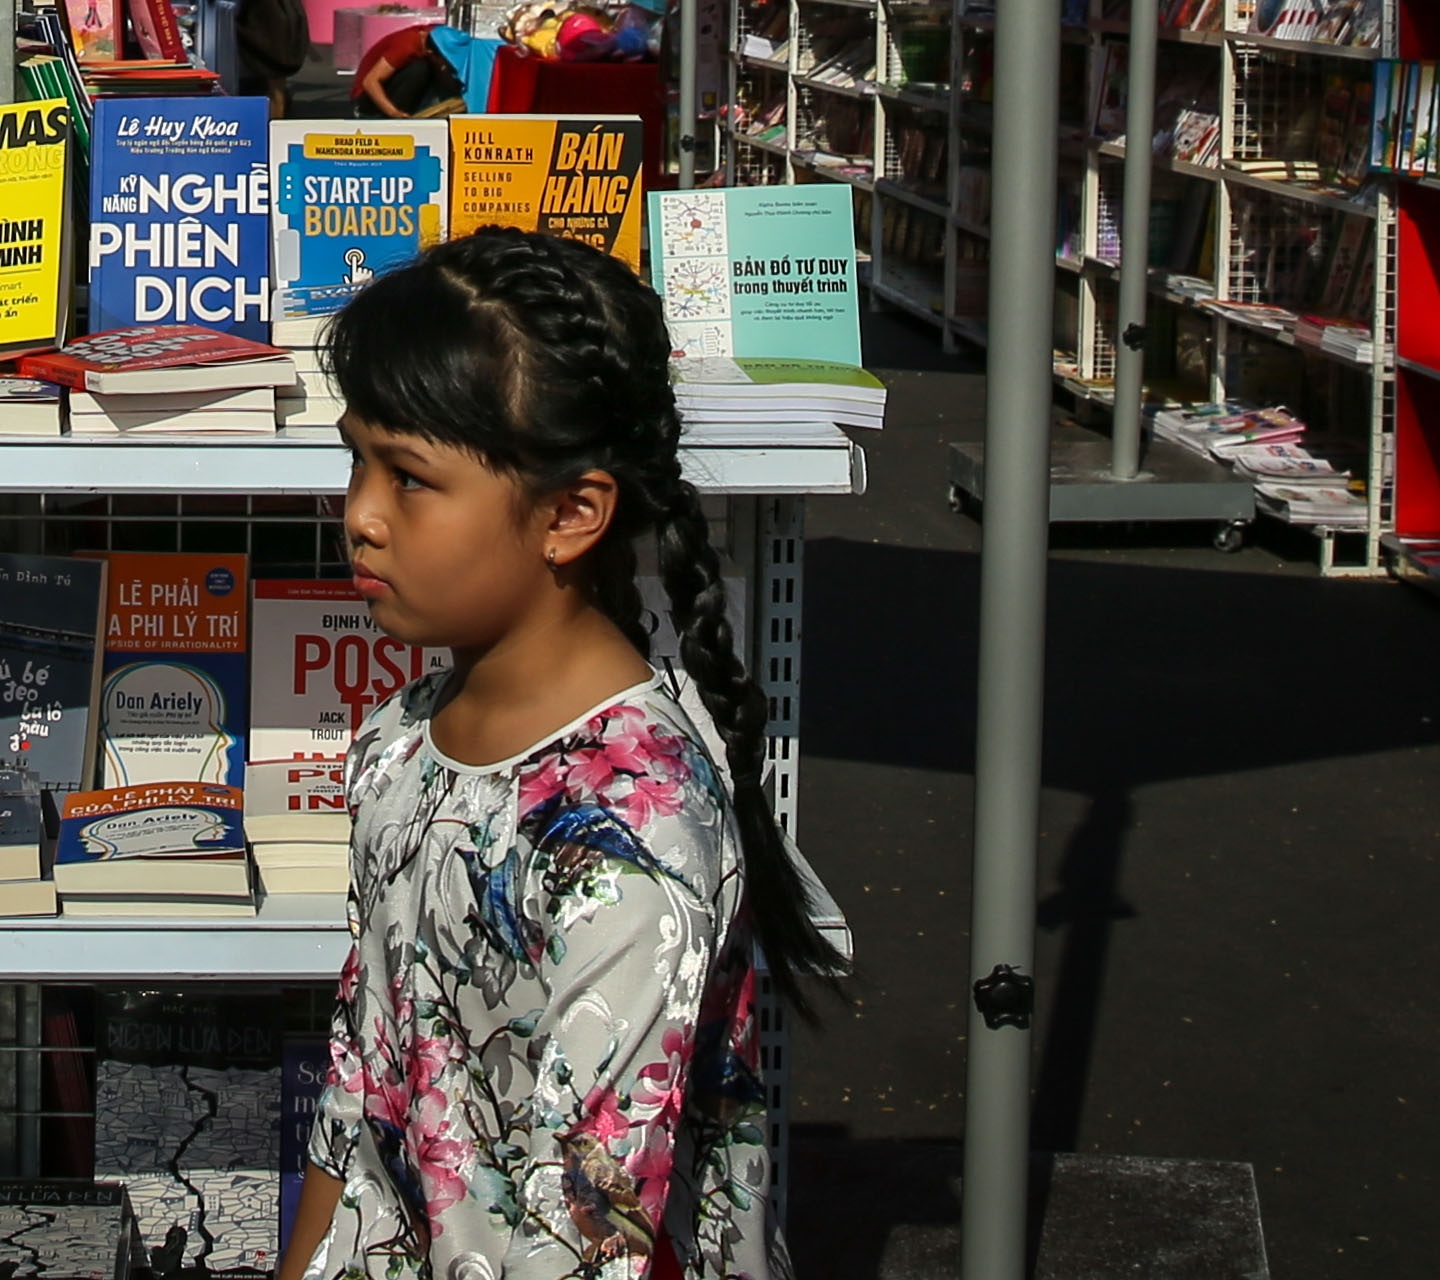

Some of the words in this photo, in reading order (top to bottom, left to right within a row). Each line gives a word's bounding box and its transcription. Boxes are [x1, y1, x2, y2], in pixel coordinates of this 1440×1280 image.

[116, 116, 141, 137] Lê
[143, 116, 186, 142] Huy
[189, 115, 240, 140] Khoa
[464, 131, 495, 145] JILL
[464, 147, 533, 161] KONRATH
[555, 124, 625, 171] BÁN
[120, 174, 138, 193] KỸ
[464, 172, 513, 182] SELLING
[303, 175, 414, 205] START-UP
[464, 187, 479, 198] TO
[483, 187, 503, 198] BIG
[541, 168, 630, 215] HÀNG
[102, 194, 138, 213] NĂNG
[463, 202, 531, 213] COMPANIES
[304, 204, 415, 238] BOARDS
[89, 216, 239, 268] PHIÊN
[732, 255, 766, 277] BẢN
[795, 257, 816, 276] TƯ
[818, 258, 848, 276] DUY
[733, 280, 769, 295] trong
[772, 276, 814, 295] thuyết
[816, 278, 848, 293] trình
[119, 578, 143, 607] LẼ
[150, 576, 200, 608] PHẢI
[130, 613, 165, 638] PHI
[172, 609, 199, 638] LÝ
[205, 609, 239, 638] TRÍ
[322, 614, 360, 632] ĐỊNH
[160, 640, 240, 650] IRRATIONALITY
[430, 656, 445, 668] AL
[21, 659, 52, 687] bé
[116, 691, 145, 710] Dan
[149, 691, 204, 715] Ariely
[318, 712, 346, 724] JACK
[310, 728, 345, 741] TROUT
